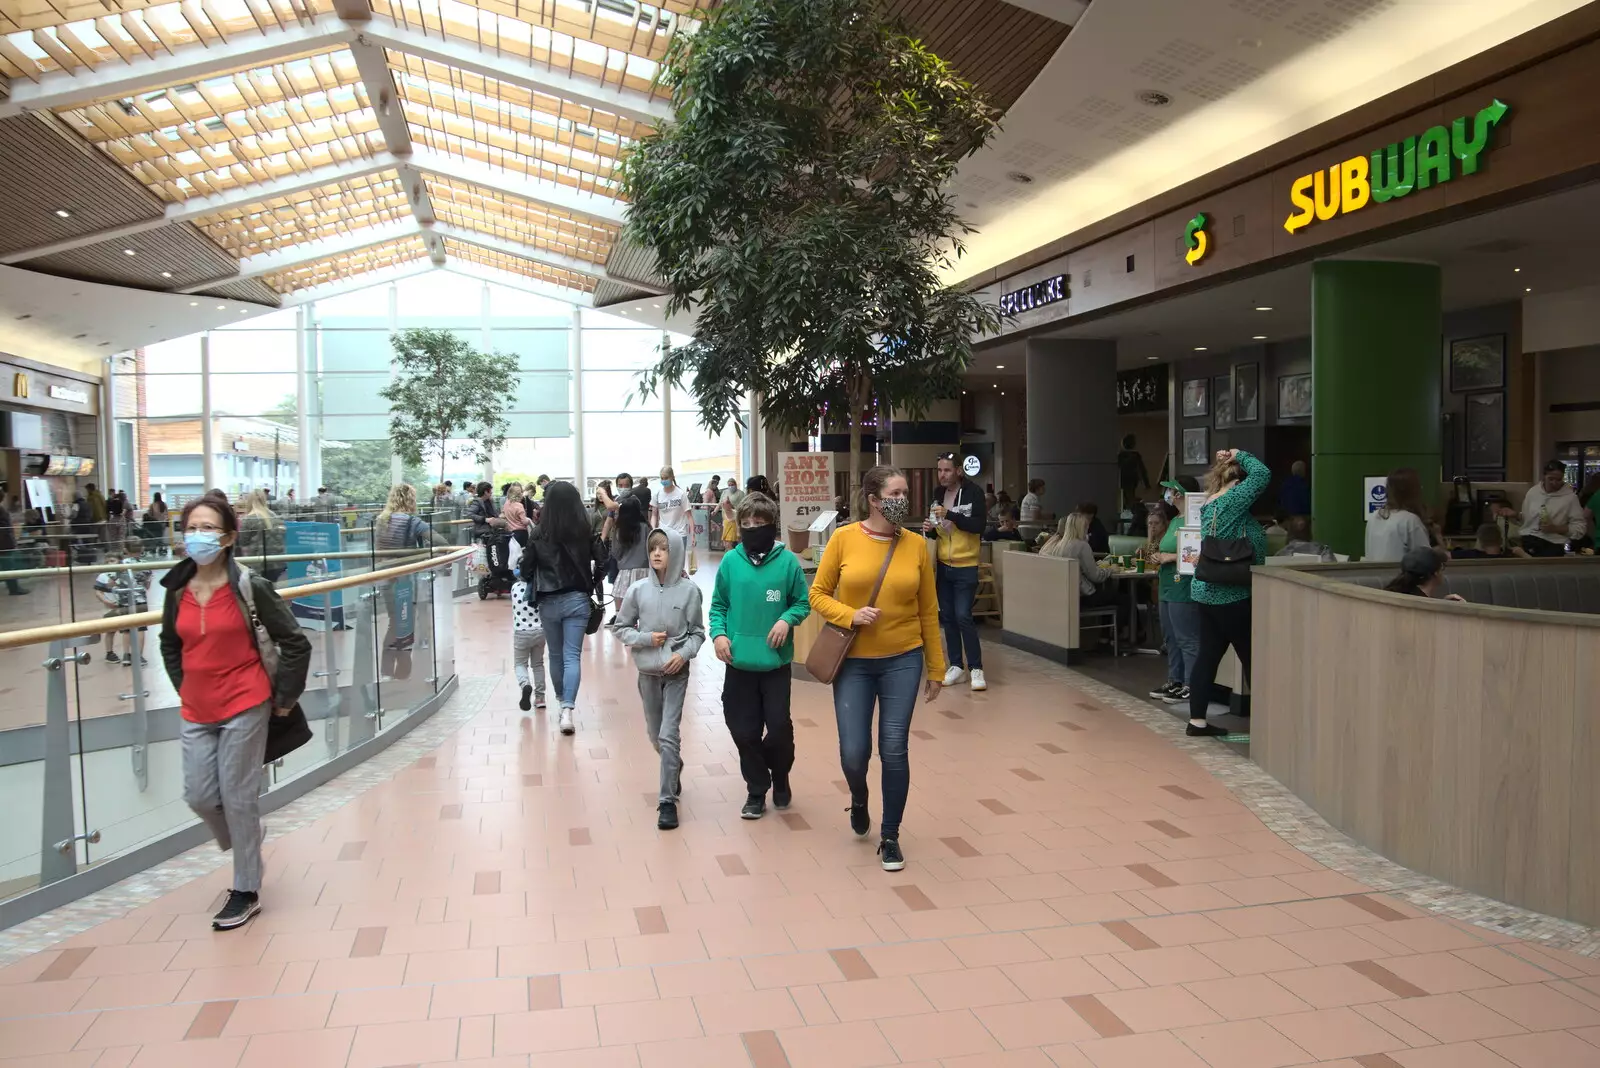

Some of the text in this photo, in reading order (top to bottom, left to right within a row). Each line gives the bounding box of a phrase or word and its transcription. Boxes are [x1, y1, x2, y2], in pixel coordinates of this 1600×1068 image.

[1284, 99, 1508, 235] SUBWAY
[784, 456, 829, 469] ANY
[784, 470, 829, 485] HOT
[785, 486, 829, 495] DRINK
[796, 506, 821, 516] £1.99
